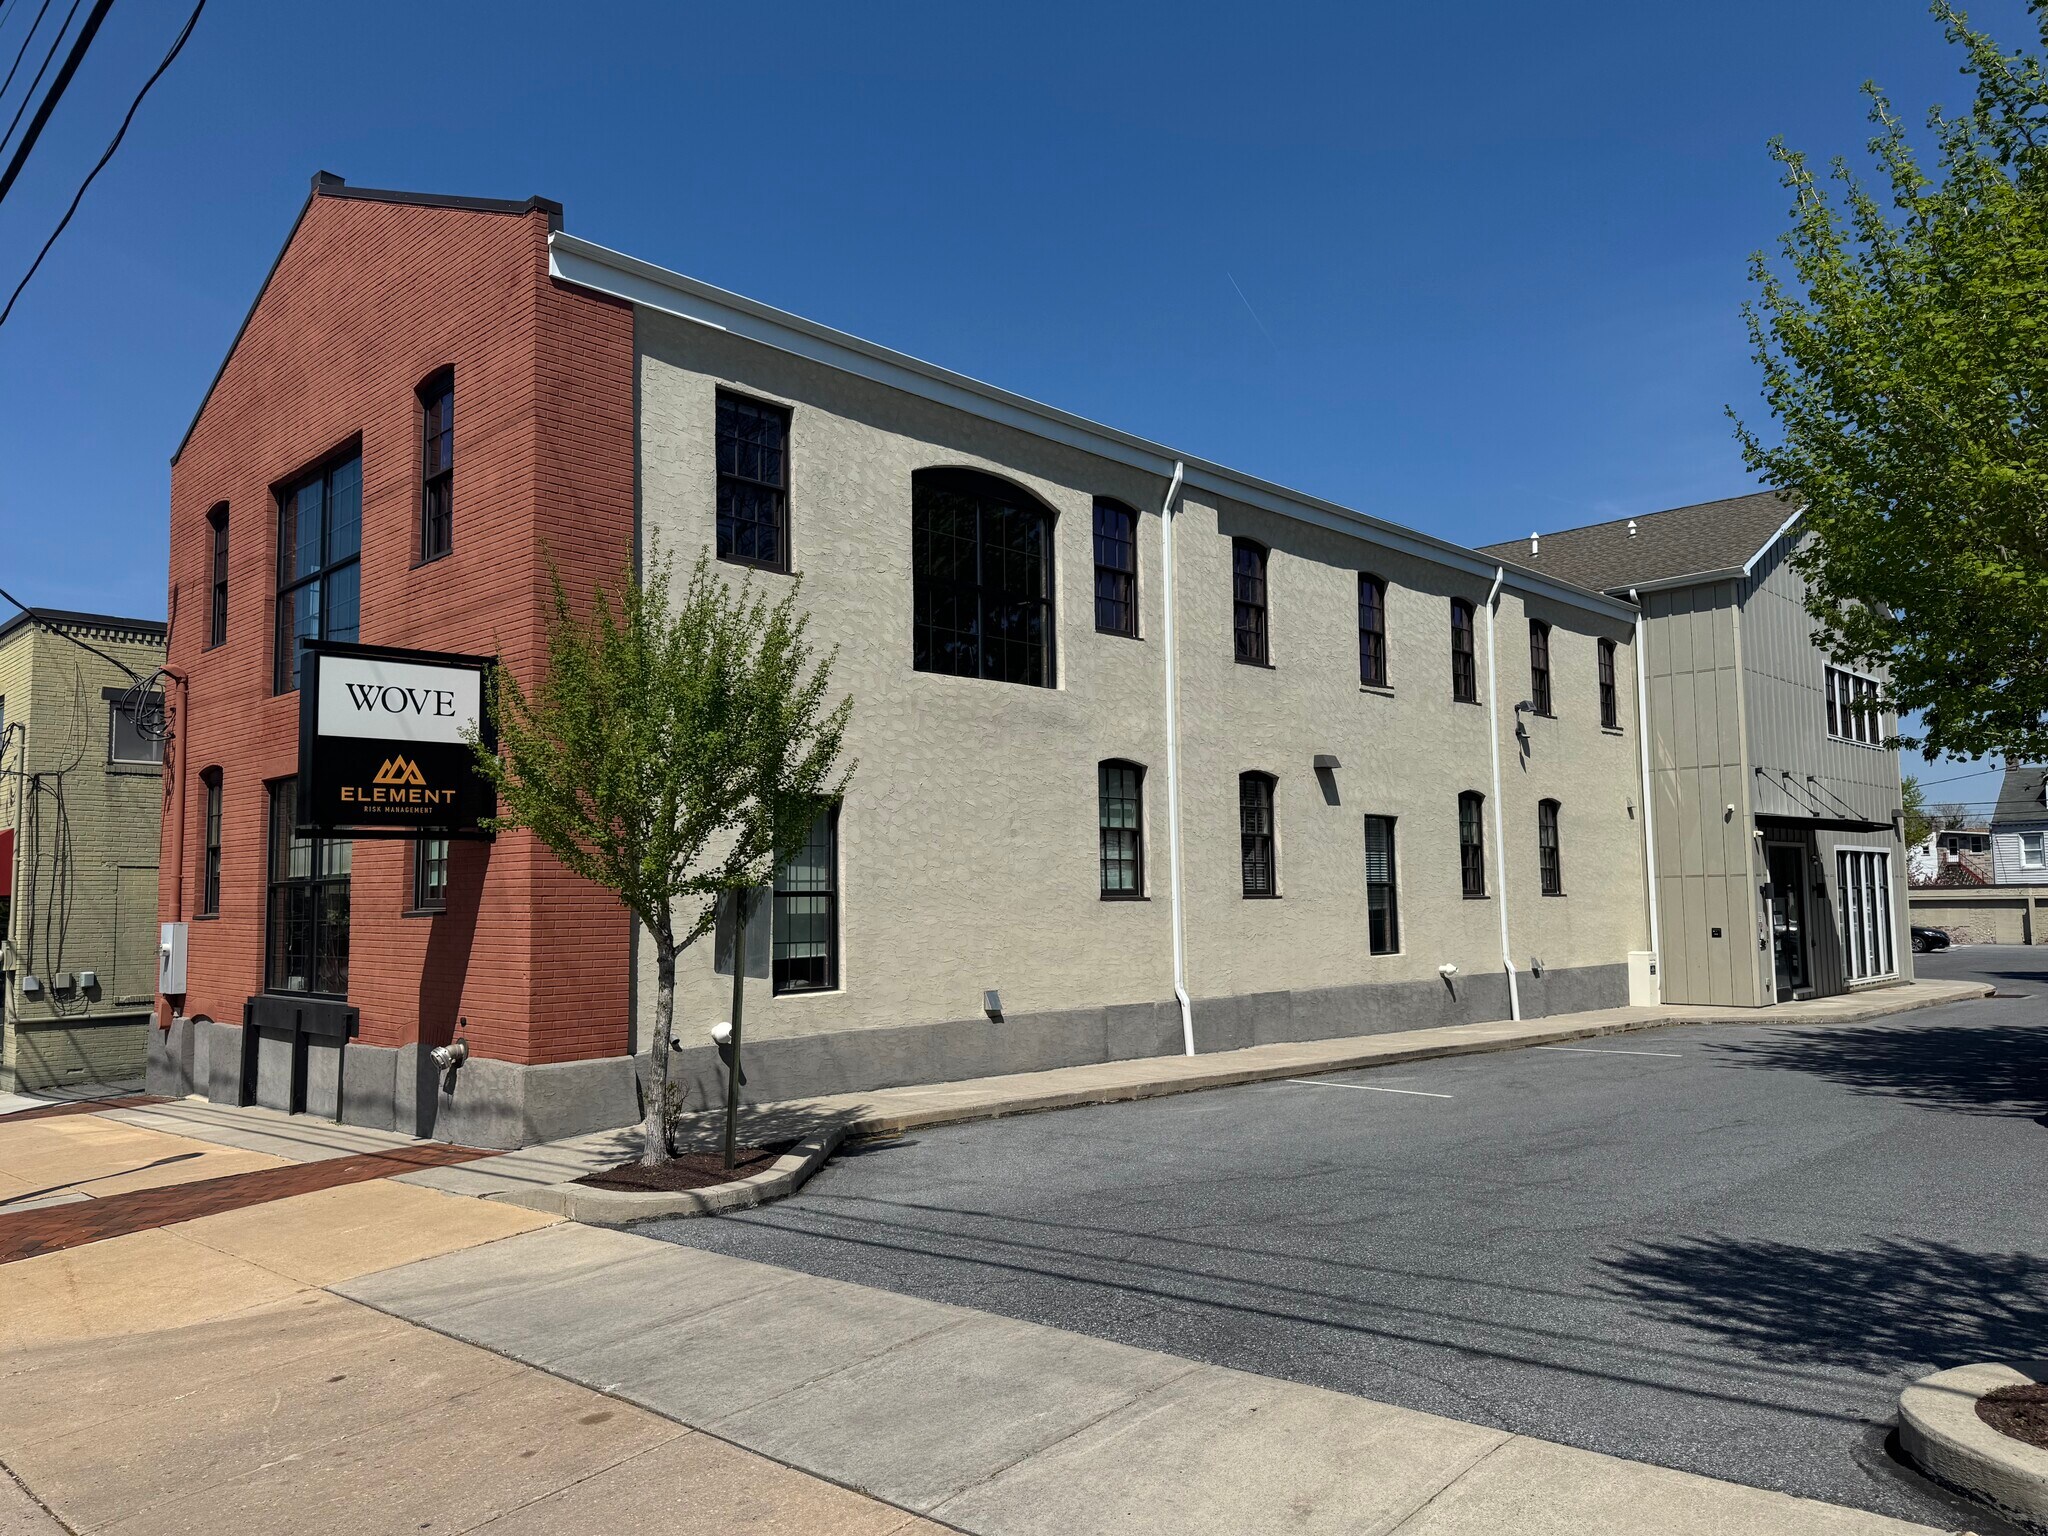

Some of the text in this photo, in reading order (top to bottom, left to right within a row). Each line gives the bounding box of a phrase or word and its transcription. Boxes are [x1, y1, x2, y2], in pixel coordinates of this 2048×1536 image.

[345, 683, 456, 717] WOVE
[341, 787, 456, 804] ELEMENT
[363, 805, 433, 814] RISK MANAGEMENT
